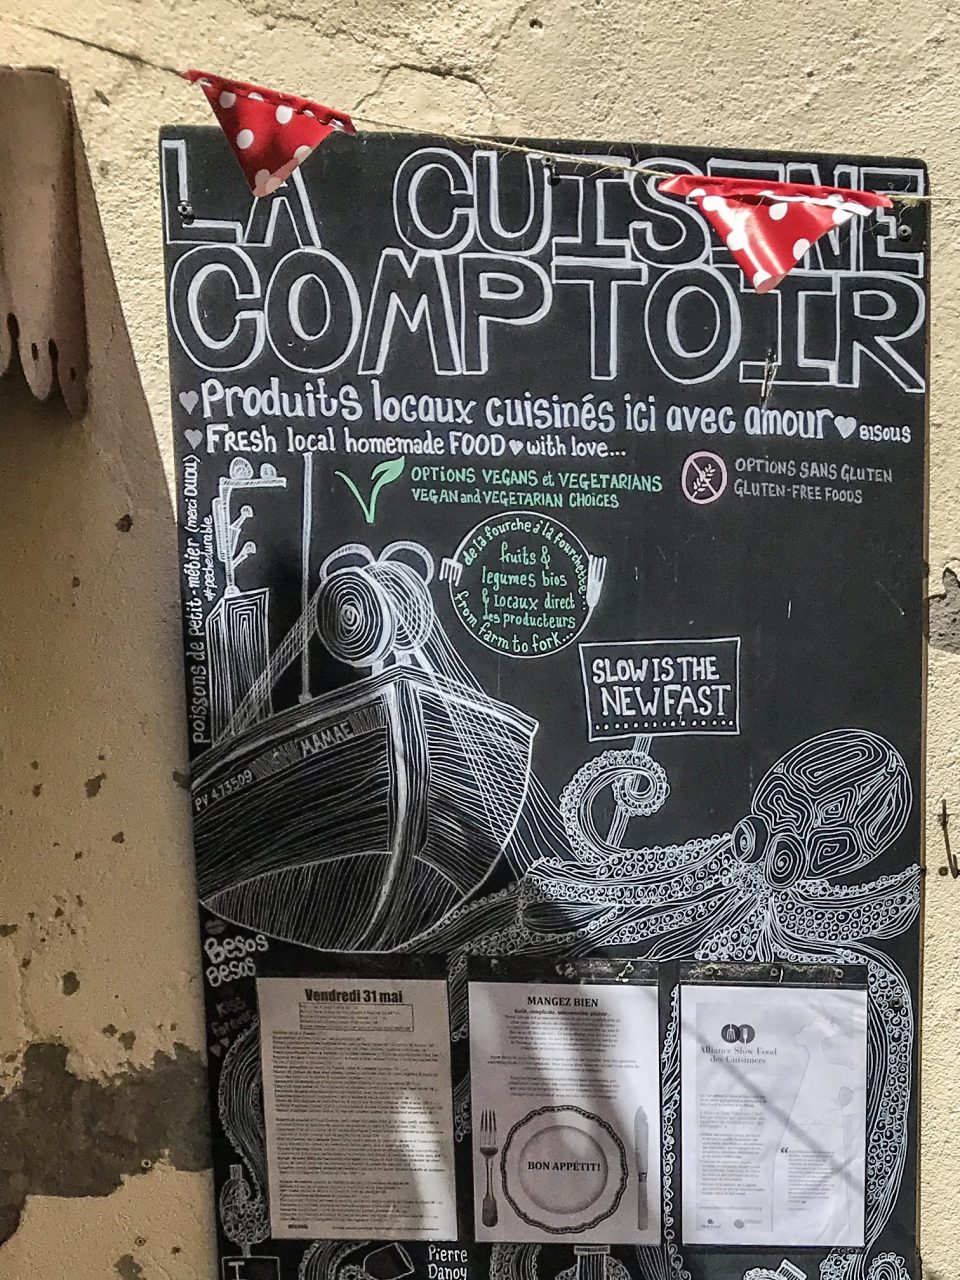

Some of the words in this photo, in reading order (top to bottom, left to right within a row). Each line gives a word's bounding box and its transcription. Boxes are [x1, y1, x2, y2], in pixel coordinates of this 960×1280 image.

[161, 138, 321, 249] LA
[393, 147, 925, 278] CUISNE
[170, 244, 926, 392] COMPTOIR
[201, 377, 363, 421] Produits
[370, 379, 477, 424] locaux
[485, 393, 616, 433] cuisinés
[624, 393, 656, 432] ici
[666, 405, 736, 434] avec
[744, 407, 833, 440] amour
[287, 425, 336, 452] local
[346, 427, 444, 455] homemade
[449, 432, 505, 456] FOOD
[526, 436, 568, 456] with
[481, 468, 538, 486] VEGANS
[542, 473, 555, 487] et
[558, 473, 663, 492] VEGETARIANS
[800, 461, 837, 480] SANS
[840, 463, 893, 483] GLUTEN
[411, 487, 458, 504] VEGAN
[460, 492, 482, 504] and
[484, 492, 563, 508] VEGETARIAN
[734, 478, 821, 500] GLUTEN-FREE
[824, 488, 863, 504] FOODS
[462, 546, 478, 566] de
[473, 536, 487, 551] la
[484, 518, 532, 541] fourche
[542, 522, 554, 540] la
[499, 541, 537, 565] fruits
[540, 546, 551, 570] &
[541, 570, 568, 587] bios
[544, 592, 576, 610] direct
[454, 590, 478, 628] from
[478, 622, 510, 650] farm
[512, 634, 529, 653] to
[503, 612, 576, 629] producteurs
[185, 641, 206, 661] de
[592, 658, 649, 684] SLOW
[652, 657, 674, 682] IS
[677, 656, 720, 682] THE
[186, 664, 211, 744] poissons
[600, 685, 661, 716] NEW
[664, 684, 731, 716] FAST
[304, 988, 361, 1002] Vendredi
[363, 990, 376, 1003] 31
[379, 990, 403, 1003] mai
[527, 996, 572, 1007] MANGEZ
[573, 997, 599, 1008] BIEN
[527, 1161, 550, 1171] BON
[428, 1245, 468, 1263] Pierre
